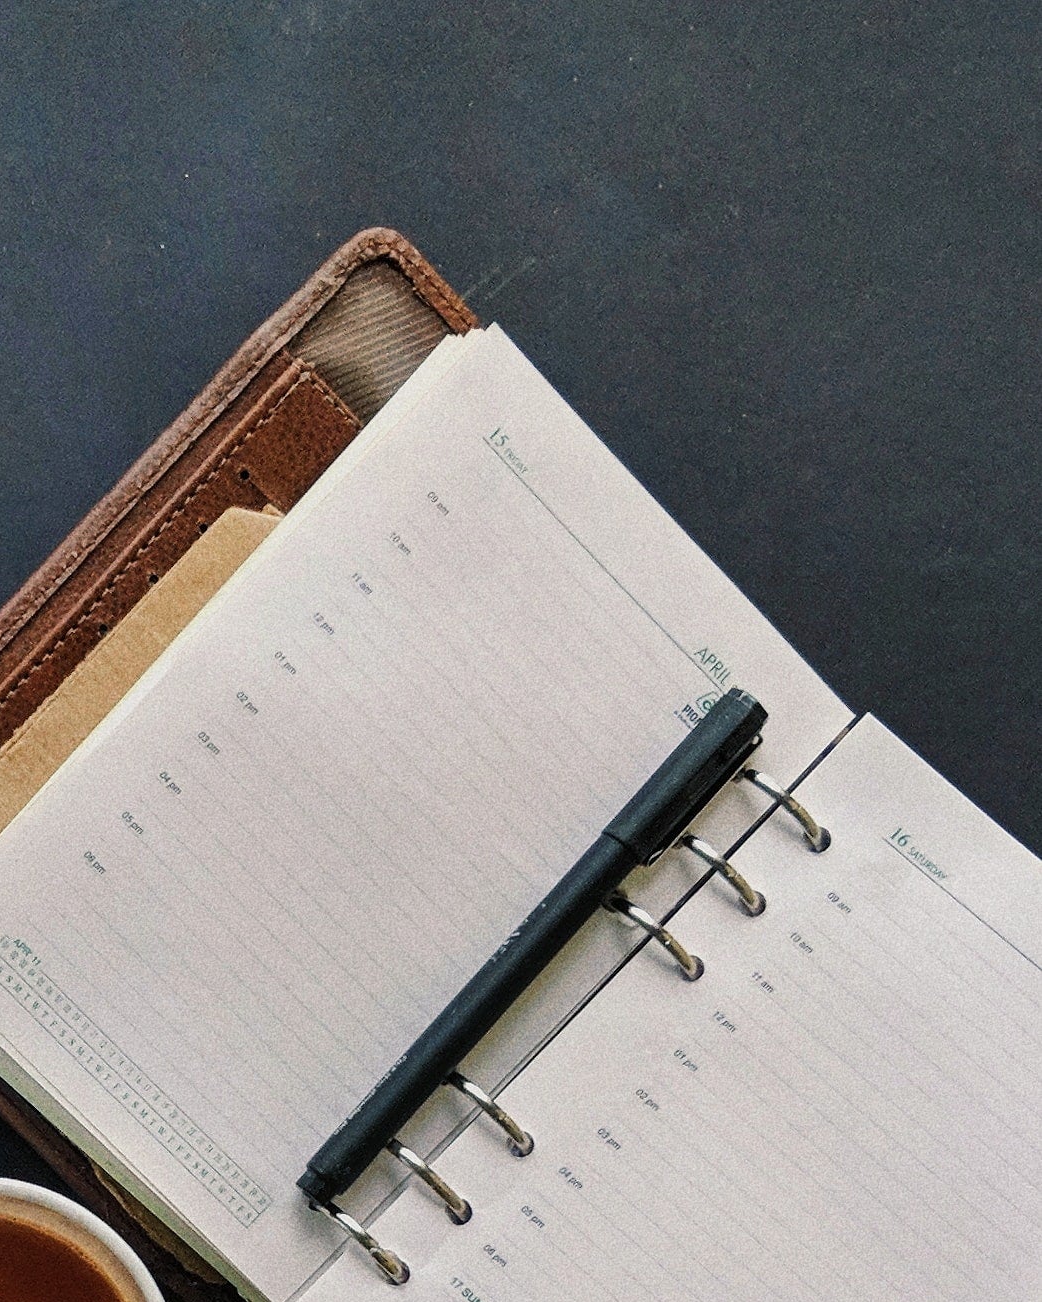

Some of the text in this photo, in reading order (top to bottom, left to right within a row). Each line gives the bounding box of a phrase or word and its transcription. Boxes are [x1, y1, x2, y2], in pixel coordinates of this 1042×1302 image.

[489, 427, 509, 447] 15
[427, 491, 439, 503] 09
[319, 622, 335, 635] pm
[274, 651, 297, 675] 01 pm
[693, 648, 731, 686] APRIL
[236, 691, 248, 703] 02
[197, 731, 220, 755] 03 pm
[159, 771, 182, 795] 04 pm
[121, 811, 144, 835] 05 pm
[889, 827, 948, 880] 16 SATURDAY
[91, 861, 106, 875] pm
[827, 892, 852, 914] 09 am
[789, 932, 813, 954] 10 am
[760, 981, 774, 993] am
[712, 1010, 736, 1032] 12 pm
[681, 1059, 698, 1072] pm
[635, 1088, 659, 1111] 02 pm
[597, 1128, 621, 1150] 03 pm
[558, 1166, 583, 1189] 04 pm
[529, 1215, 545, 1229] pm
[491, 1254, 507, 1267] pm
[450, 1277, 463, 1288] 17
